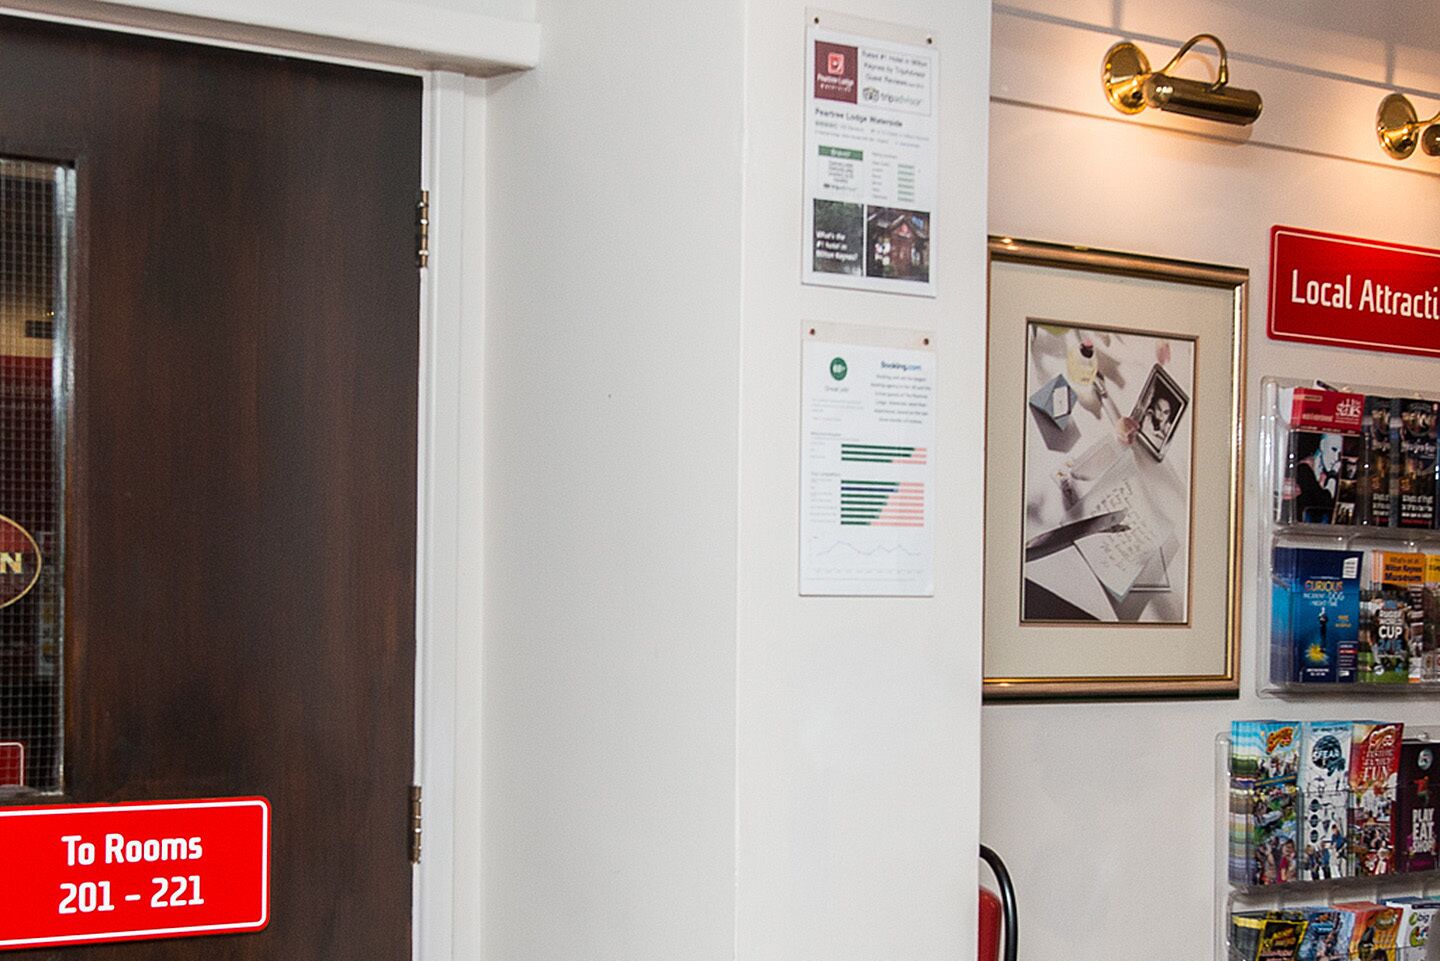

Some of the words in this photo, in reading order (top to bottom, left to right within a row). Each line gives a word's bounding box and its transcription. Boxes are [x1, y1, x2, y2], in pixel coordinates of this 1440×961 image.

[1291, 268, 1353, 310] Local
[1357, 278, 1440, 321] Attracti
[880, 361, 922, 371] Booking.com
[1378, 625, 1404, 640] CUP
[1412, 821, 1436, 841] EAT
[60, 834, 96, 867] To
[104, 831, 203, 865] Rooms
[57, 880, 115, 915] 201
[149, 874, 205, 910] 221
